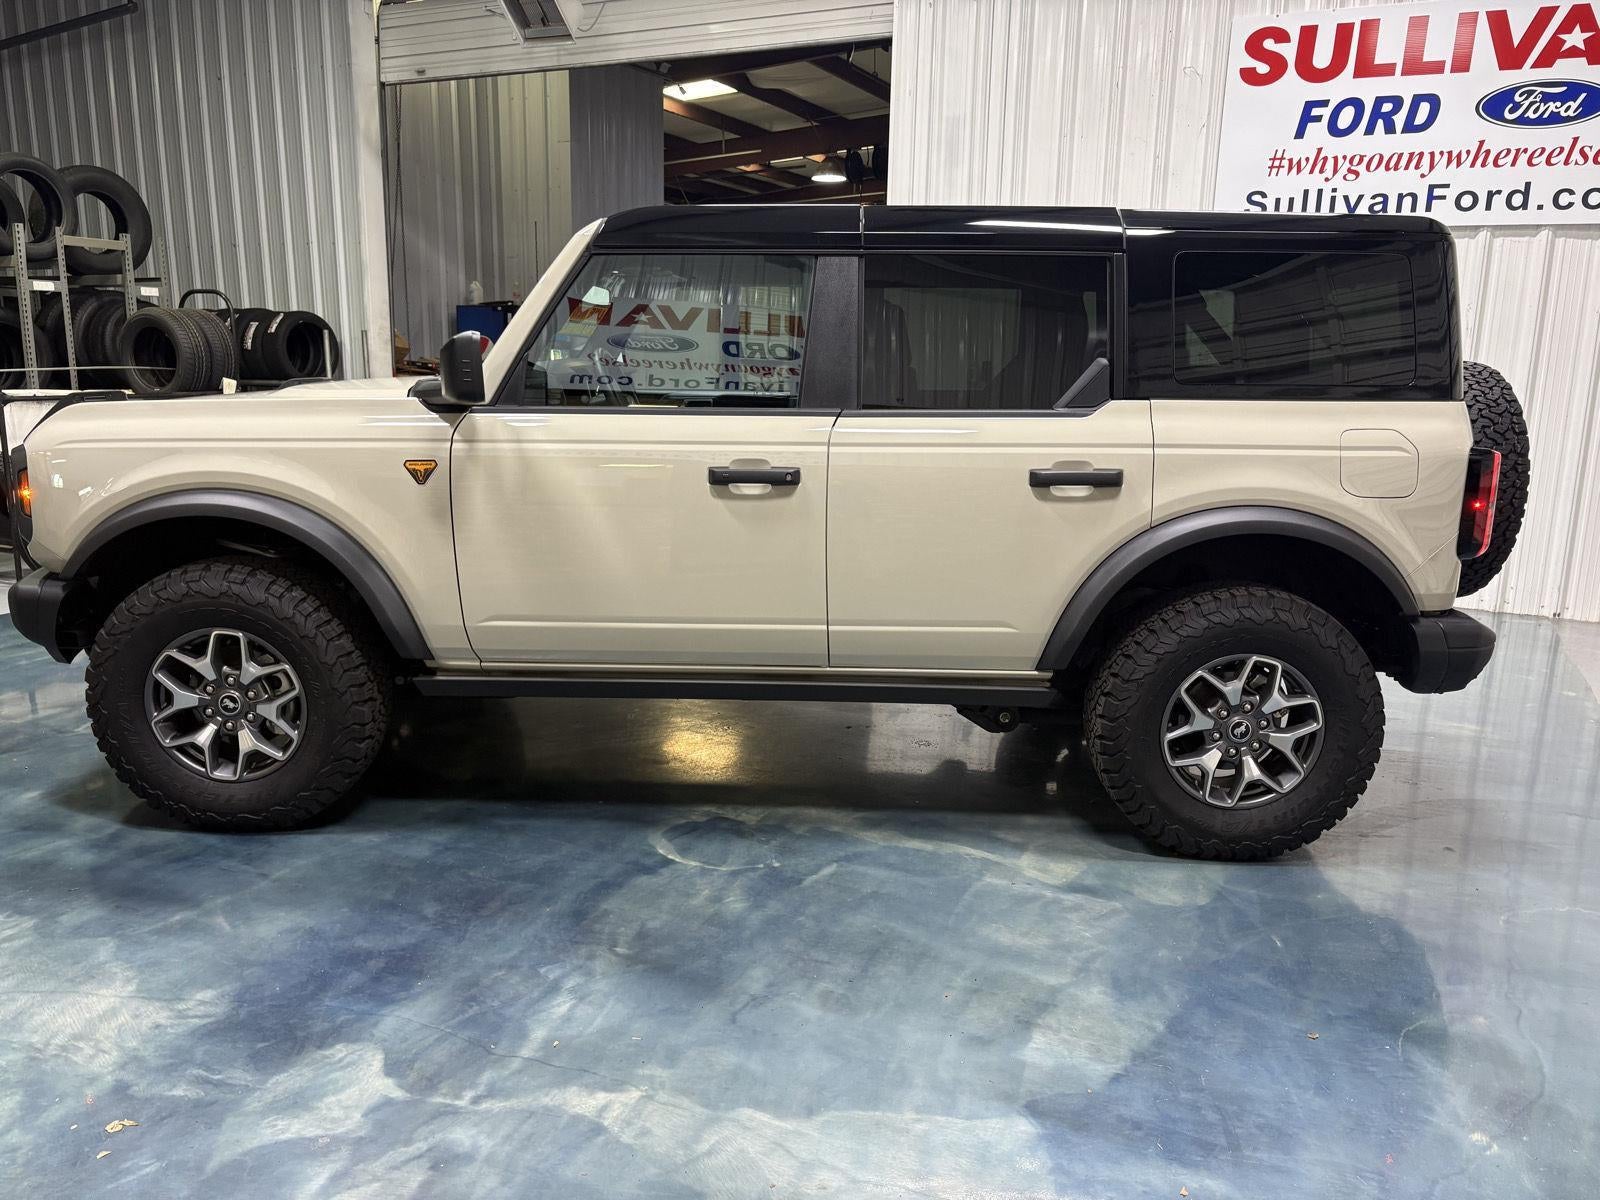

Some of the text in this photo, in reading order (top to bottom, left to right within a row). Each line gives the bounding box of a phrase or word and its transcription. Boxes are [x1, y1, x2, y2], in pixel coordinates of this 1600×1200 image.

[1239, 3, 1600, 86] SULLIVA
[1294, 93, 1441, 139] FORD
[1503, 86, 1583, 120] Ford
[1244, 182, 1600, 214] SullivanFord.co
